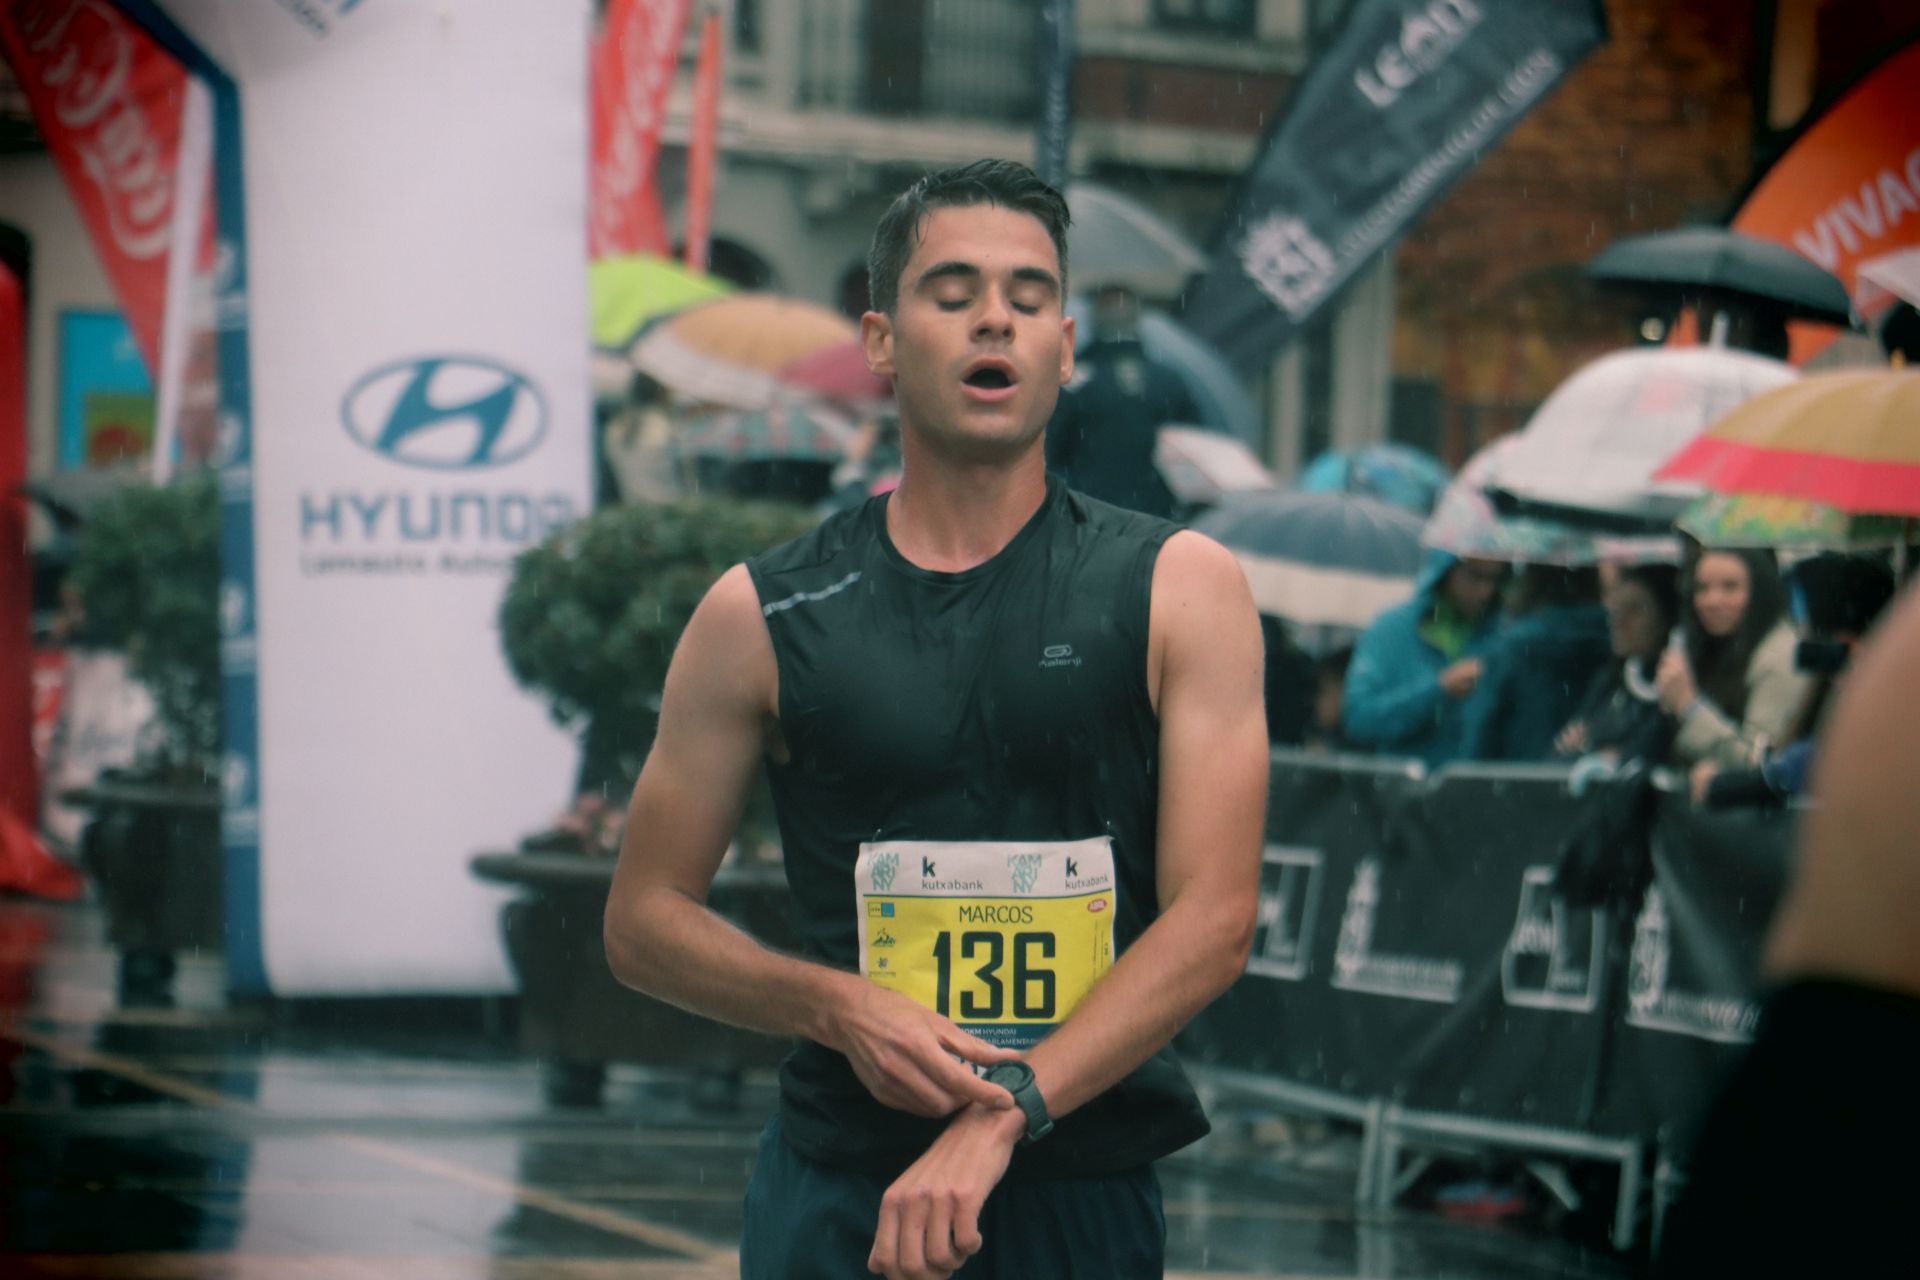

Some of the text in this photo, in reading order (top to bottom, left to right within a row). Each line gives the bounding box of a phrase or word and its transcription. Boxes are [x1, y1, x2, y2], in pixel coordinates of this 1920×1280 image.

[922, 880, 984, 890] kutxabank
[1065, 874, 1109, 890] kutxabank
[959, 905, 1033, 924] MARCOS
[932, 931, 1056, 1019] 136
